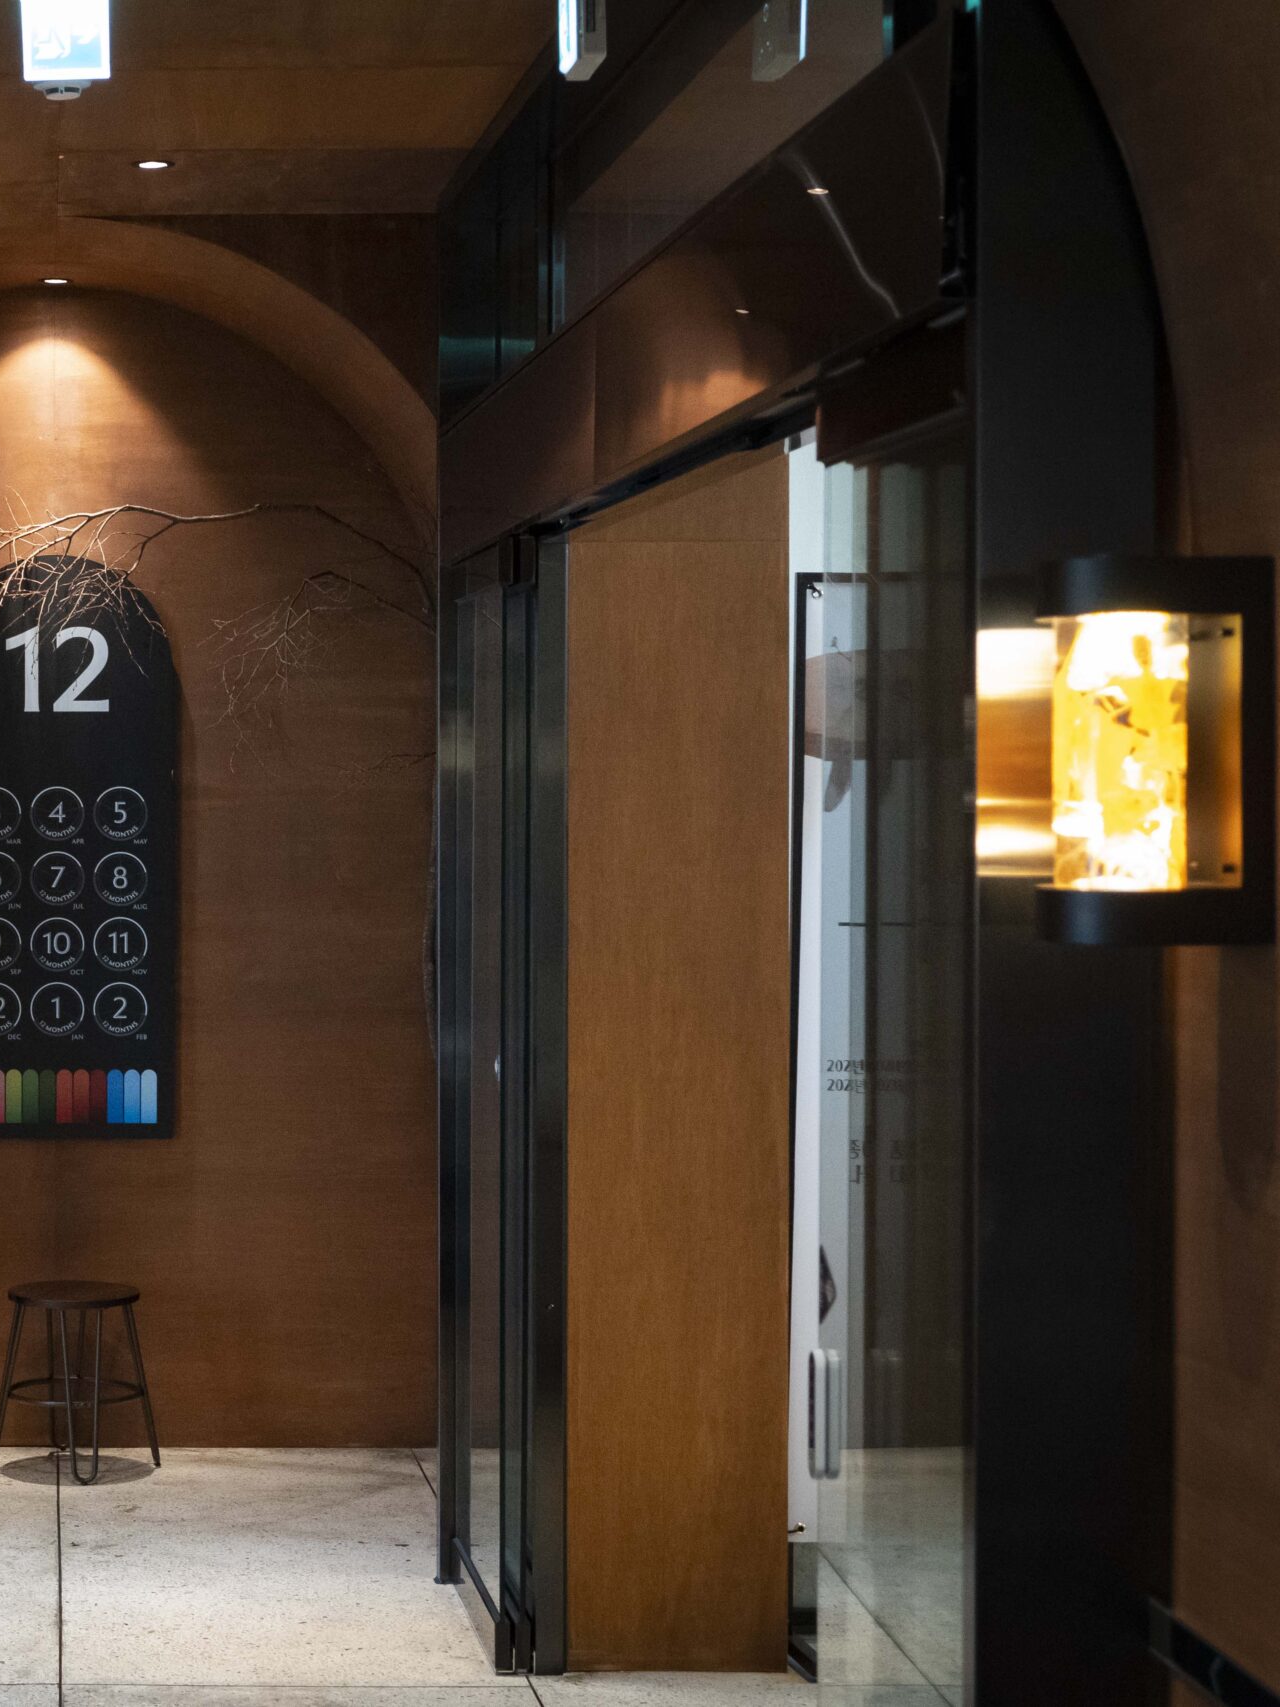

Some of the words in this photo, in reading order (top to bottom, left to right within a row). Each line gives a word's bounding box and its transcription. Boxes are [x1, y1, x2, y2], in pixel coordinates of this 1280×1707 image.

[5, 626, 110, 712] 12
[48, 801, 65, 823] 4
[114, 802, 127, 824] 5
[45, 825, 75, 838] MONTHS
[109, 825, 139, 838] MONTHS
[51, 866, 65, 888] 7
[113, 866, 128, 889] 8
[45, 890, 75, 903] MONTHS
[109, 890, 139, 903] MONTHS
[42, 932, 70, 954] 10
[108, 932, 128, 954] 11
[45, 956, 75, 968] MONTHS
[109, 956, 139, 968] MONTHS
[51, 997, 60, 1019] 1
[113, 997, 127, 1019] 2
[45, 1021, 75, 1033] MONTHS
[109, 1021, 139, 1033] MONTHS
